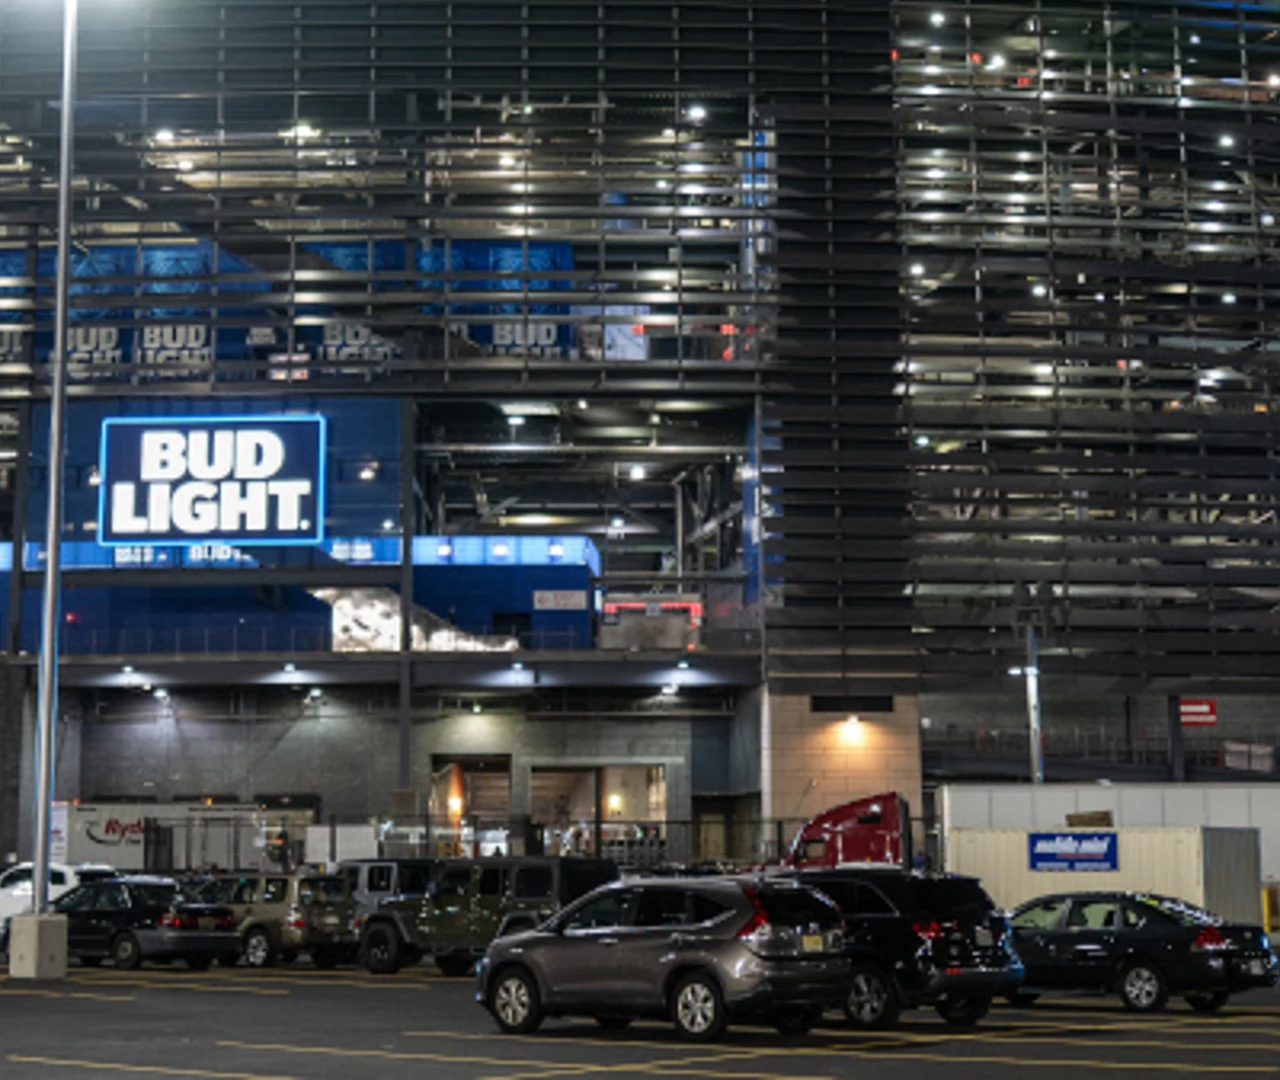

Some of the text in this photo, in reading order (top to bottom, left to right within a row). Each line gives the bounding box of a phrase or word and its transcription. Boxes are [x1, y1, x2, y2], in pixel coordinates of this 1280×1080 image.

[143, 324, 206, 348] BUD
[493, 322, 558, 345] BUD
[140, 430, 285, 481] BUD
